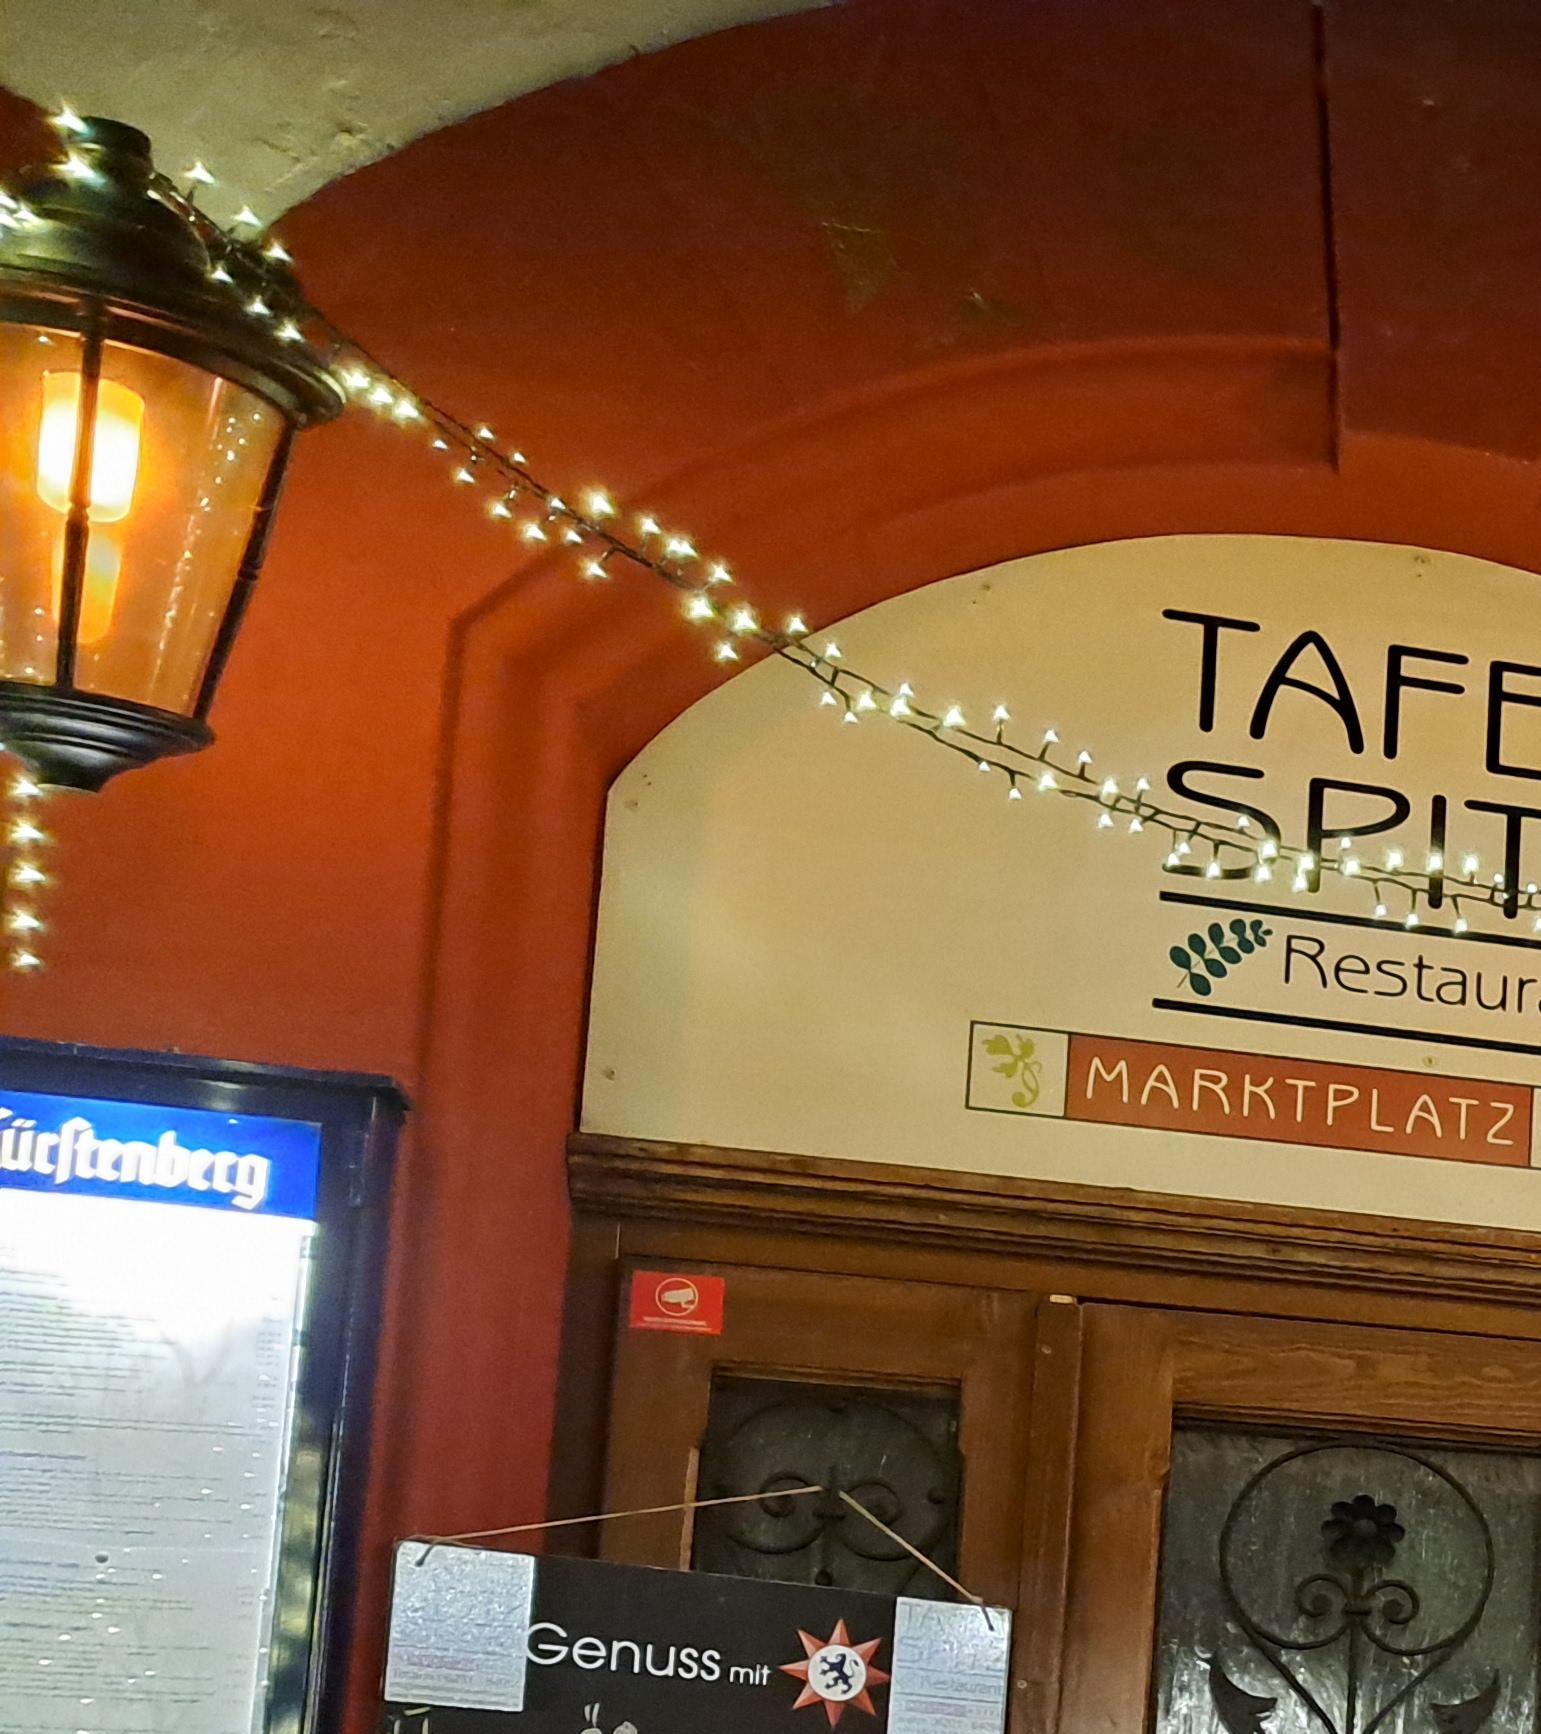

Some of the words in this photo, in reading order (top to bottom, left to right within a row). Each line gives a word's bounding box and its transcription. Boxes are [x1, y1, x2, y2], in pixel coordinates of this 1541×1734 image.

[1086, 1057, 1516, 1147] MARKTPLATZ
[524, 1621, 721, 1682] Genuss
[729, 1664, 772, 1687] mit
